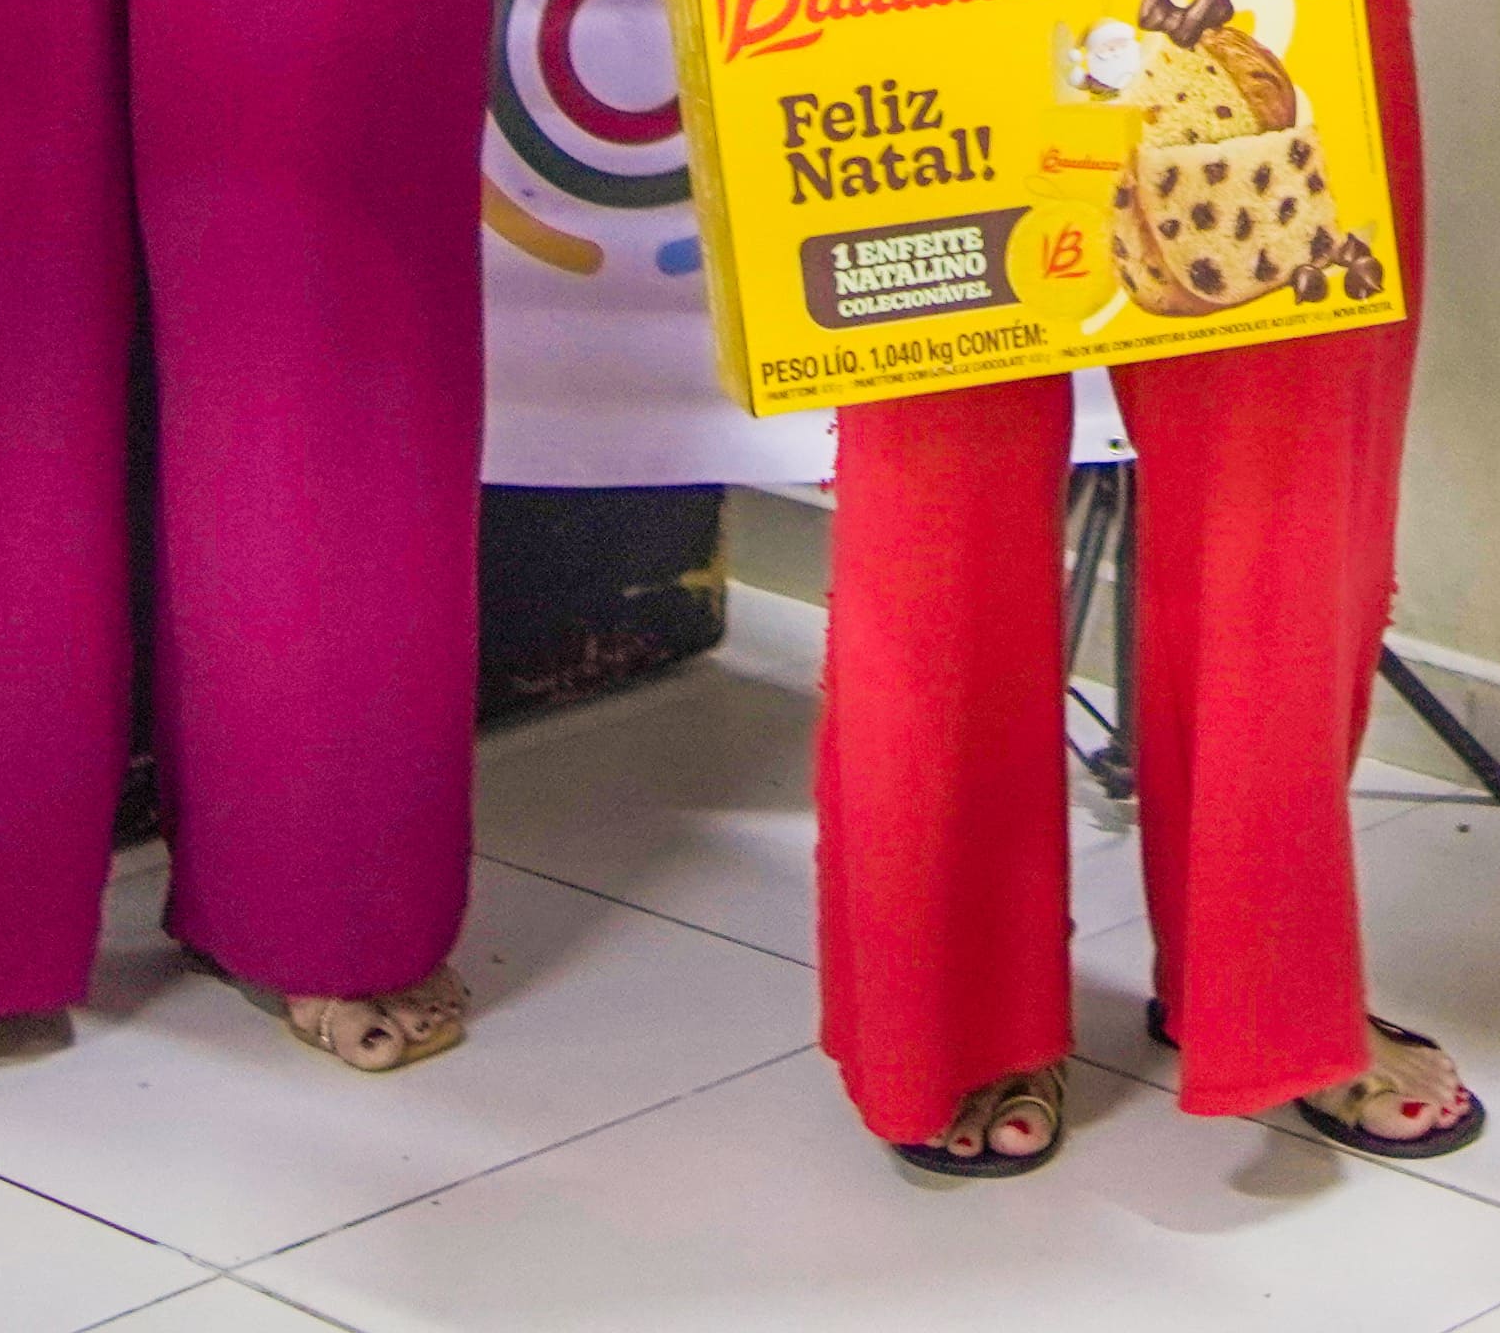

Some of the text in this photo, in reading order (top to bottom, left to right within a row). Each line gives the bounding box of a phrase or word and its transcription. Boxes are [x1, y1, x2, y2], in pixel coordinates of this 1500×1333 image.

[777, 78, 944, 149] Feliz
[784, 125, 996, 205] Natal!
[830, 225, 986, 271] 1 ENFEITE
[833, 250, 988, 296] NATALINO
[836, 280, 993, 319] COLECIONÁVEL
[761, 355, 819, 386] PESO
[823, 344, 866, 377] LÍQ.
[869, 339, 923, 373] 1,040
[927, 336, 953, 364] kg
[956, 319, 1049, 358] CONTÉM:
